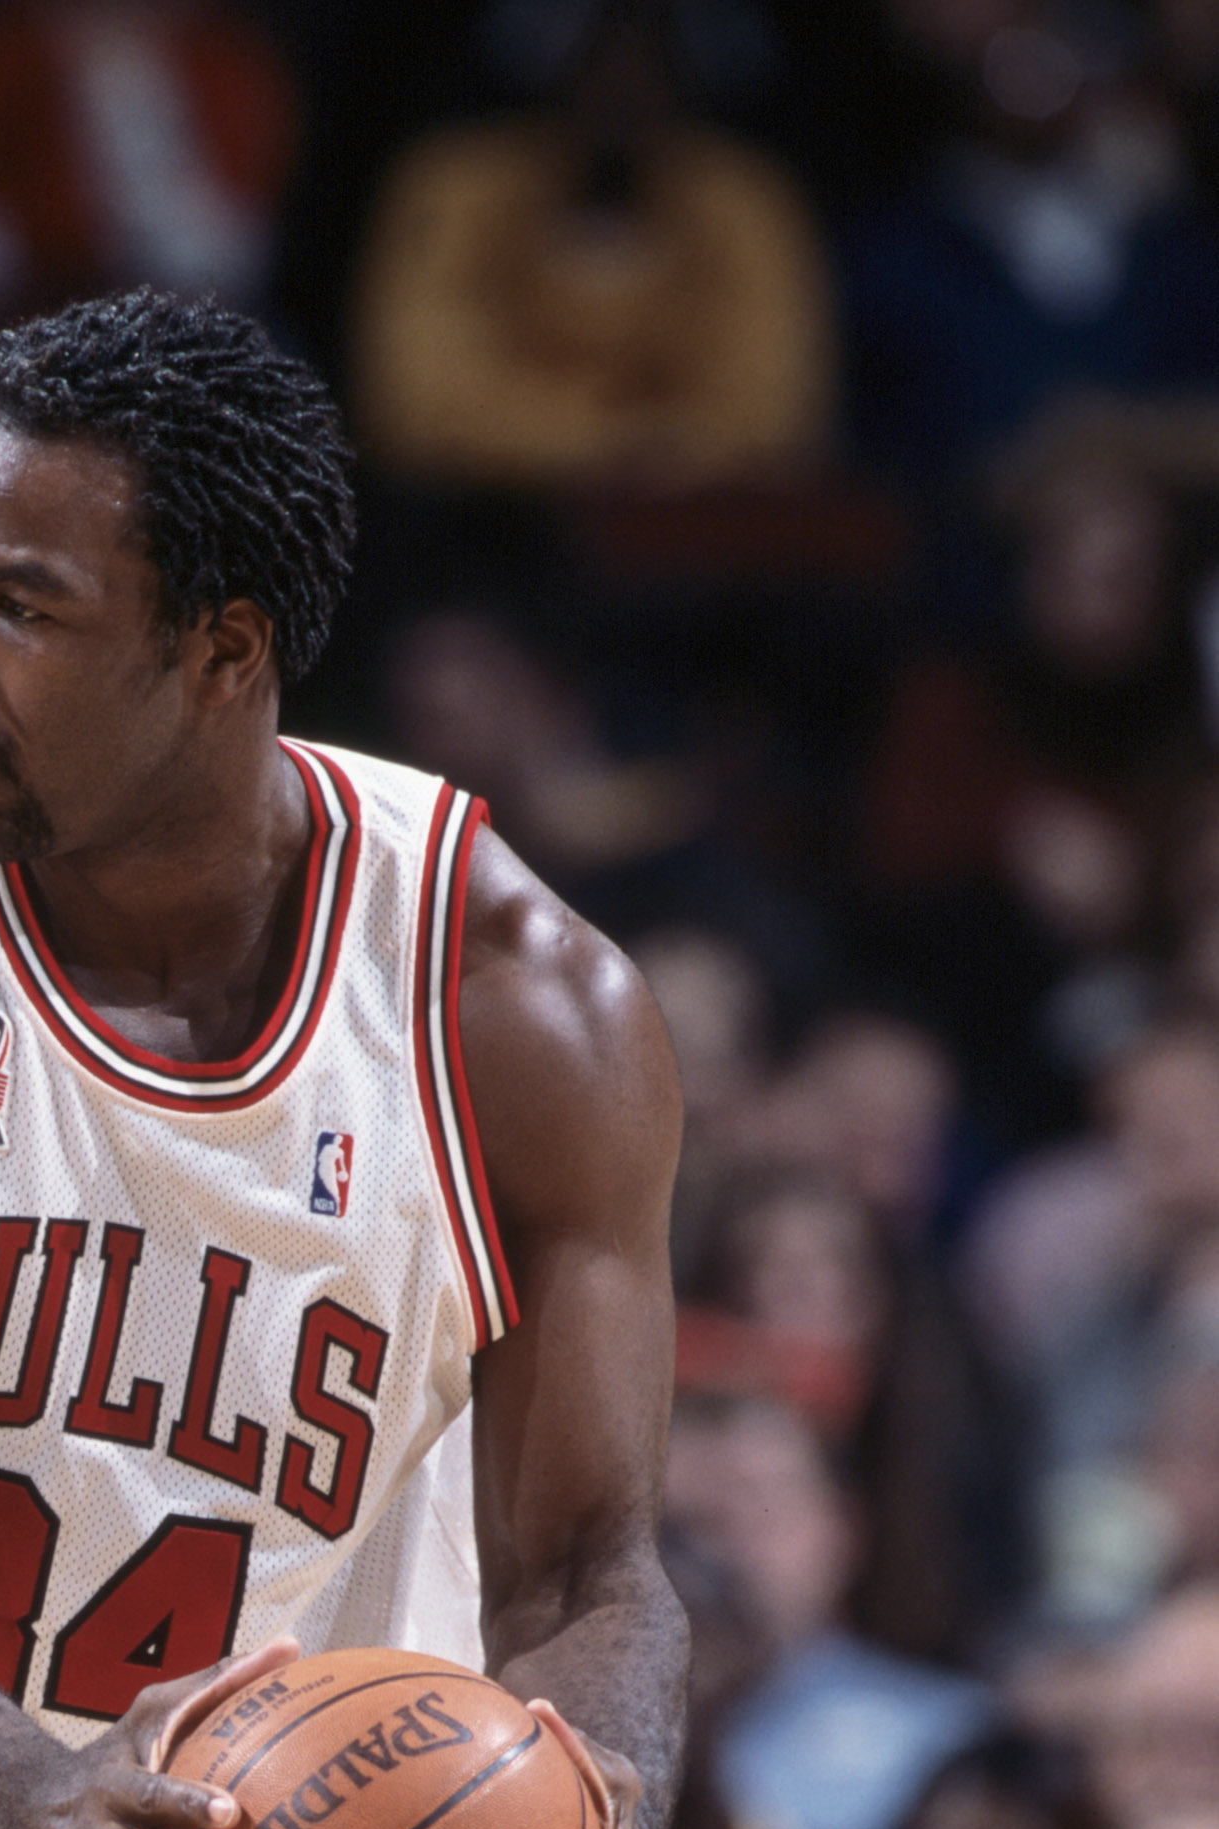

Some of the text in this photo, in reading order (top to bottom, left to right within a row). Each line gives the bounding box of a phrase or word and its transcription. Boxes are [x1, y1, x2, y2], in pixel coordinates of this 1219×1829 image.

[211, 1680, 288, 1738] NBA
[272, 1675, 334, 1710] Official
[229, 1711, 269, 1748] Game
[203, 1751, 228, 1782] Ball
